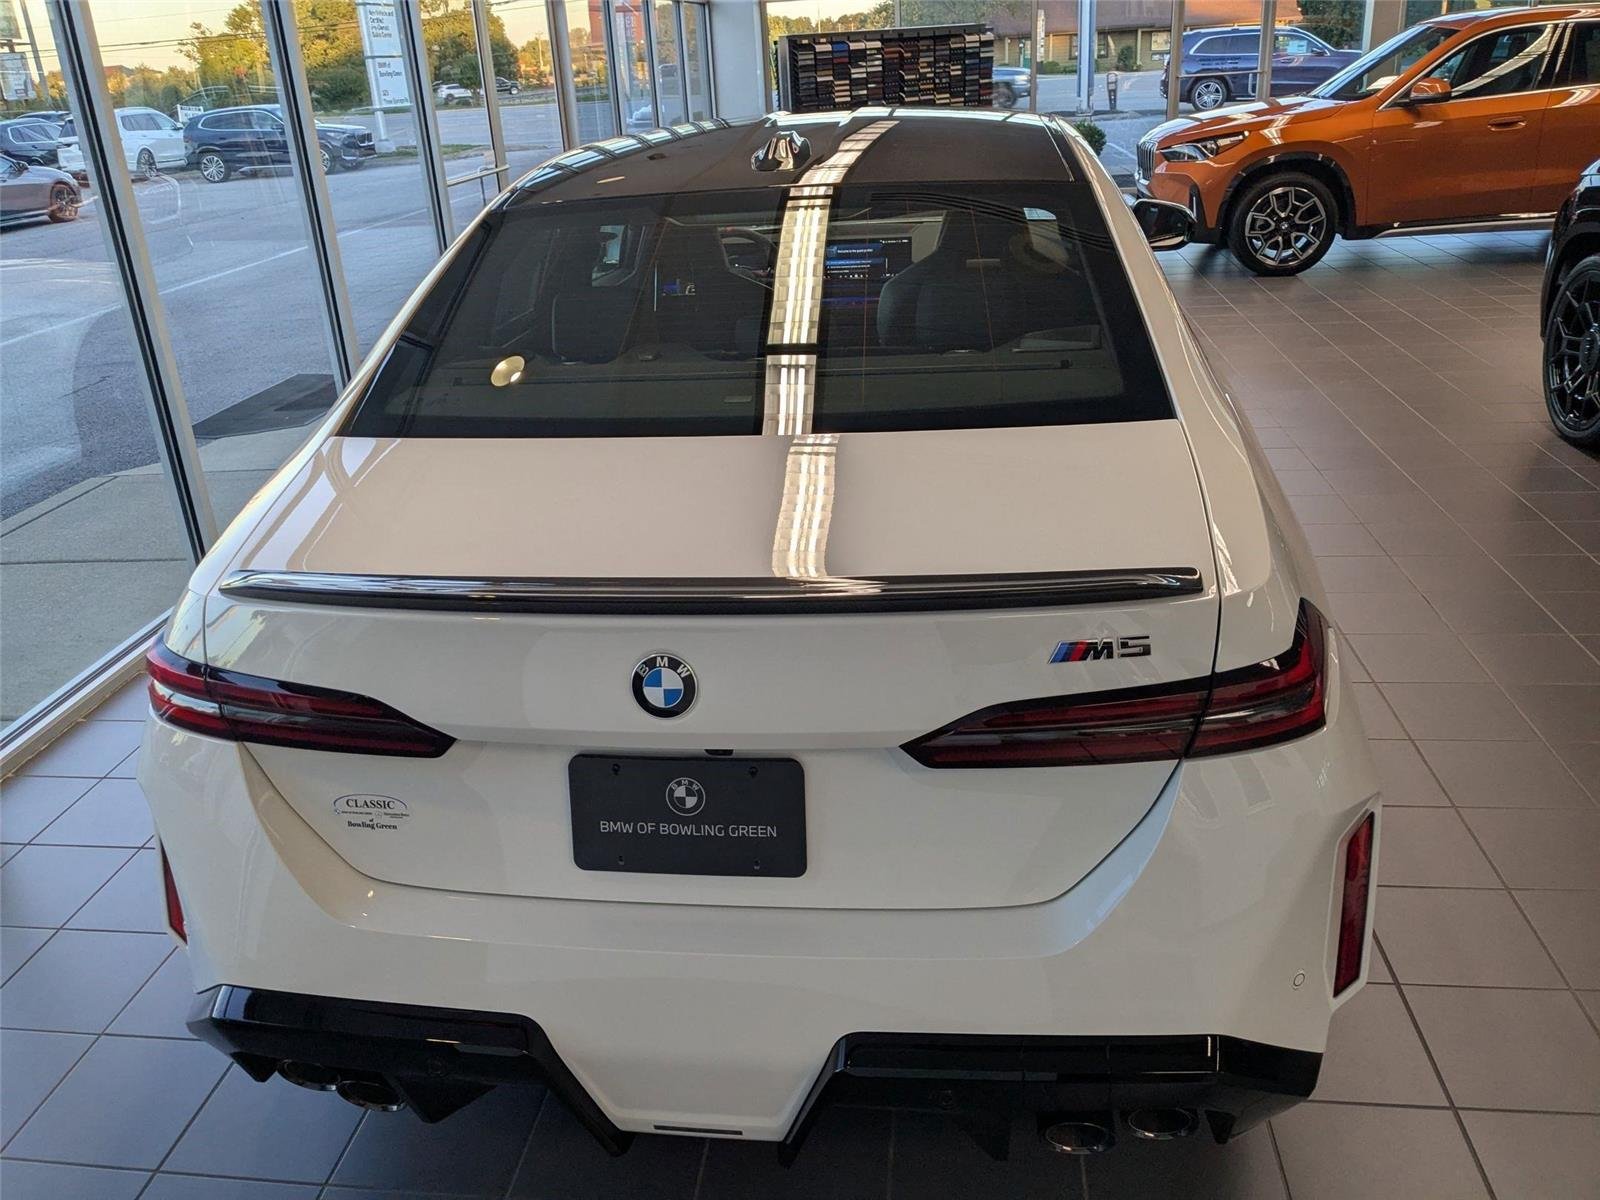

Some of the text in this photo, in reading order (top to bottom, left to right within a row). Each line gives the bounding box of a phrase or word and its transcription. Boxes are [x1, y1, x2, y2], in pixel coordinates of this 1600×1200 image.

[1080, 636, 1152, 661] M5
[636, 656, 691, 678] BMW
[671, 779, 700, 791] BMW
[346, 798, 395, 809] CLASSIC
[347, 820, 397, 830] Bowling Green
[600, 820, 777, 838] BMW OF BOWLING GREEN
